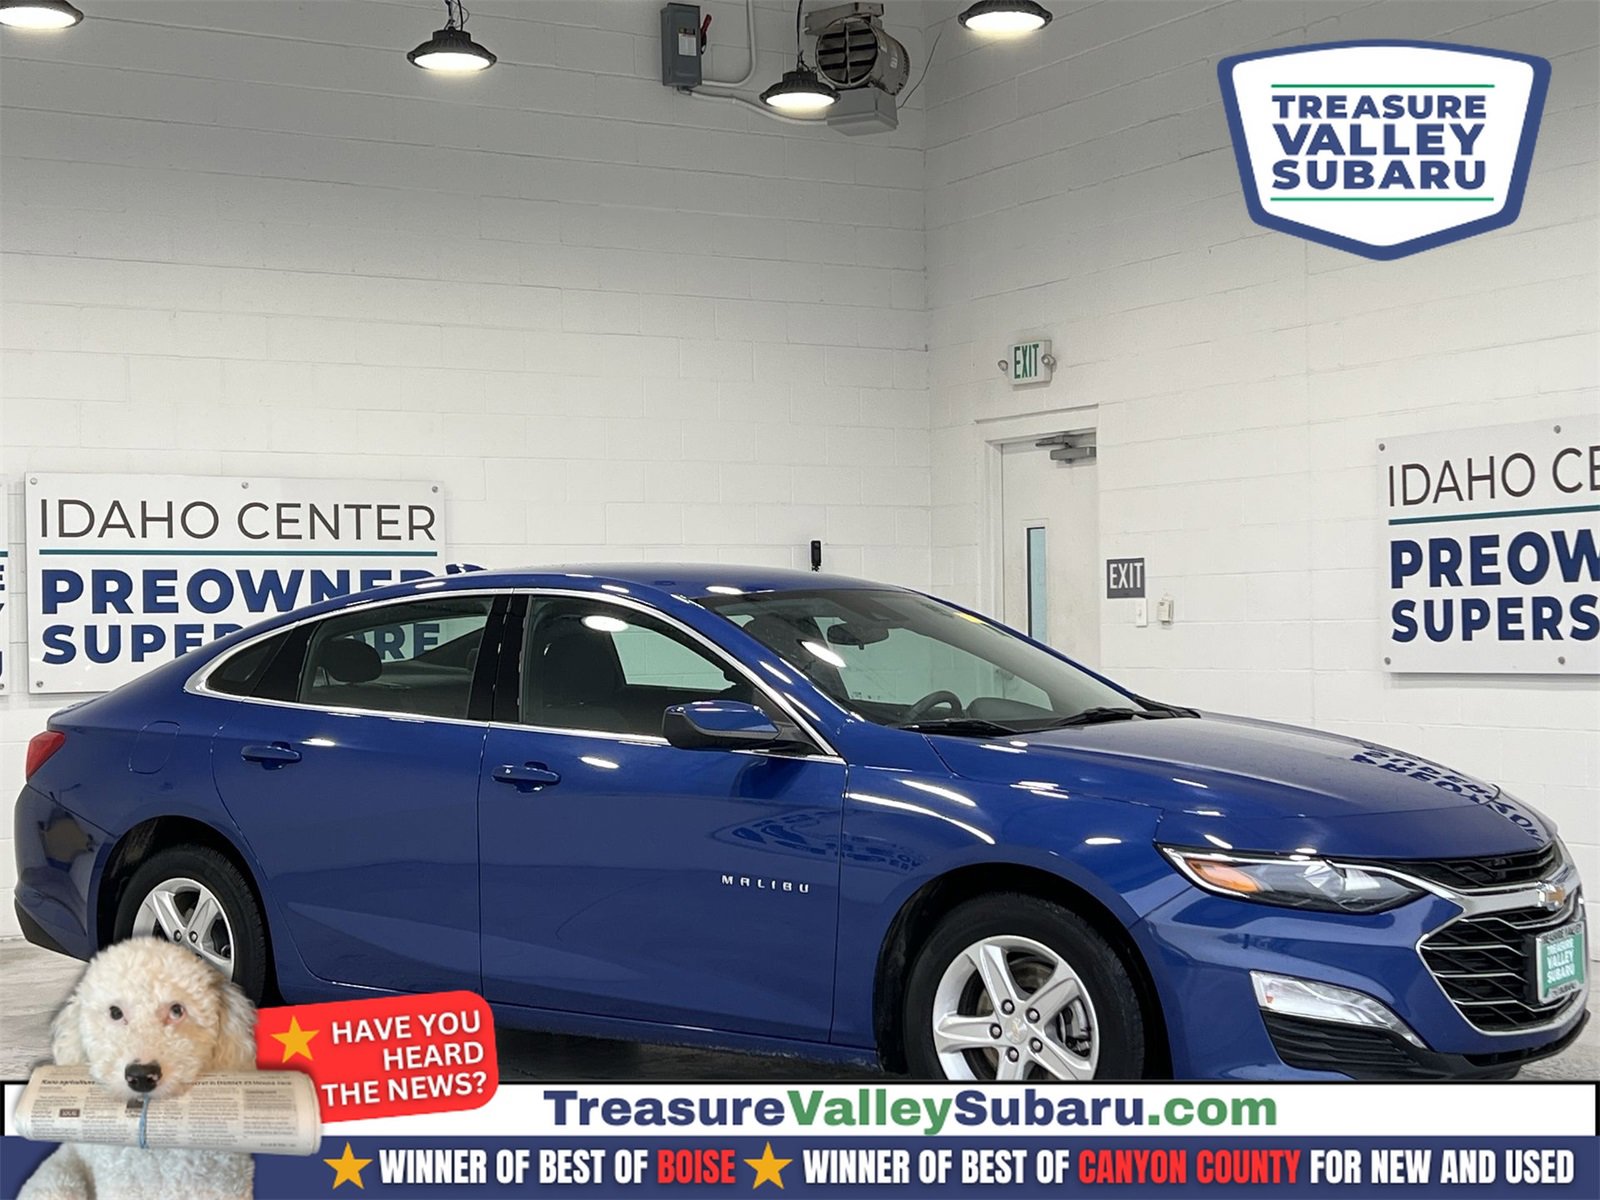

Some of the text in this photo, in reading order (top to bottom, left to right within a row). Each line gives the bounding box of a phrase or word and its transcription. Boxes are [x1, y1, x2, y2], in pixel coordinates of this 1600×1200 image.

[1013, 343, 1040, 379] EXIT
[1388, 452, 1536, 507] IDAHO
[40, 499, 436, 541] IDAHO CENTER
[41, 568, 436, 614] PREOWN
[1109, 562, 1143, 590] EXIT
[1391, 594, 1600, 642] SUPERS
[721, 874, 810, 893] MALIBU
[1547, 949, 1574, 970] VALLEY
[1547, 963, 1575, 984] SUBARU
